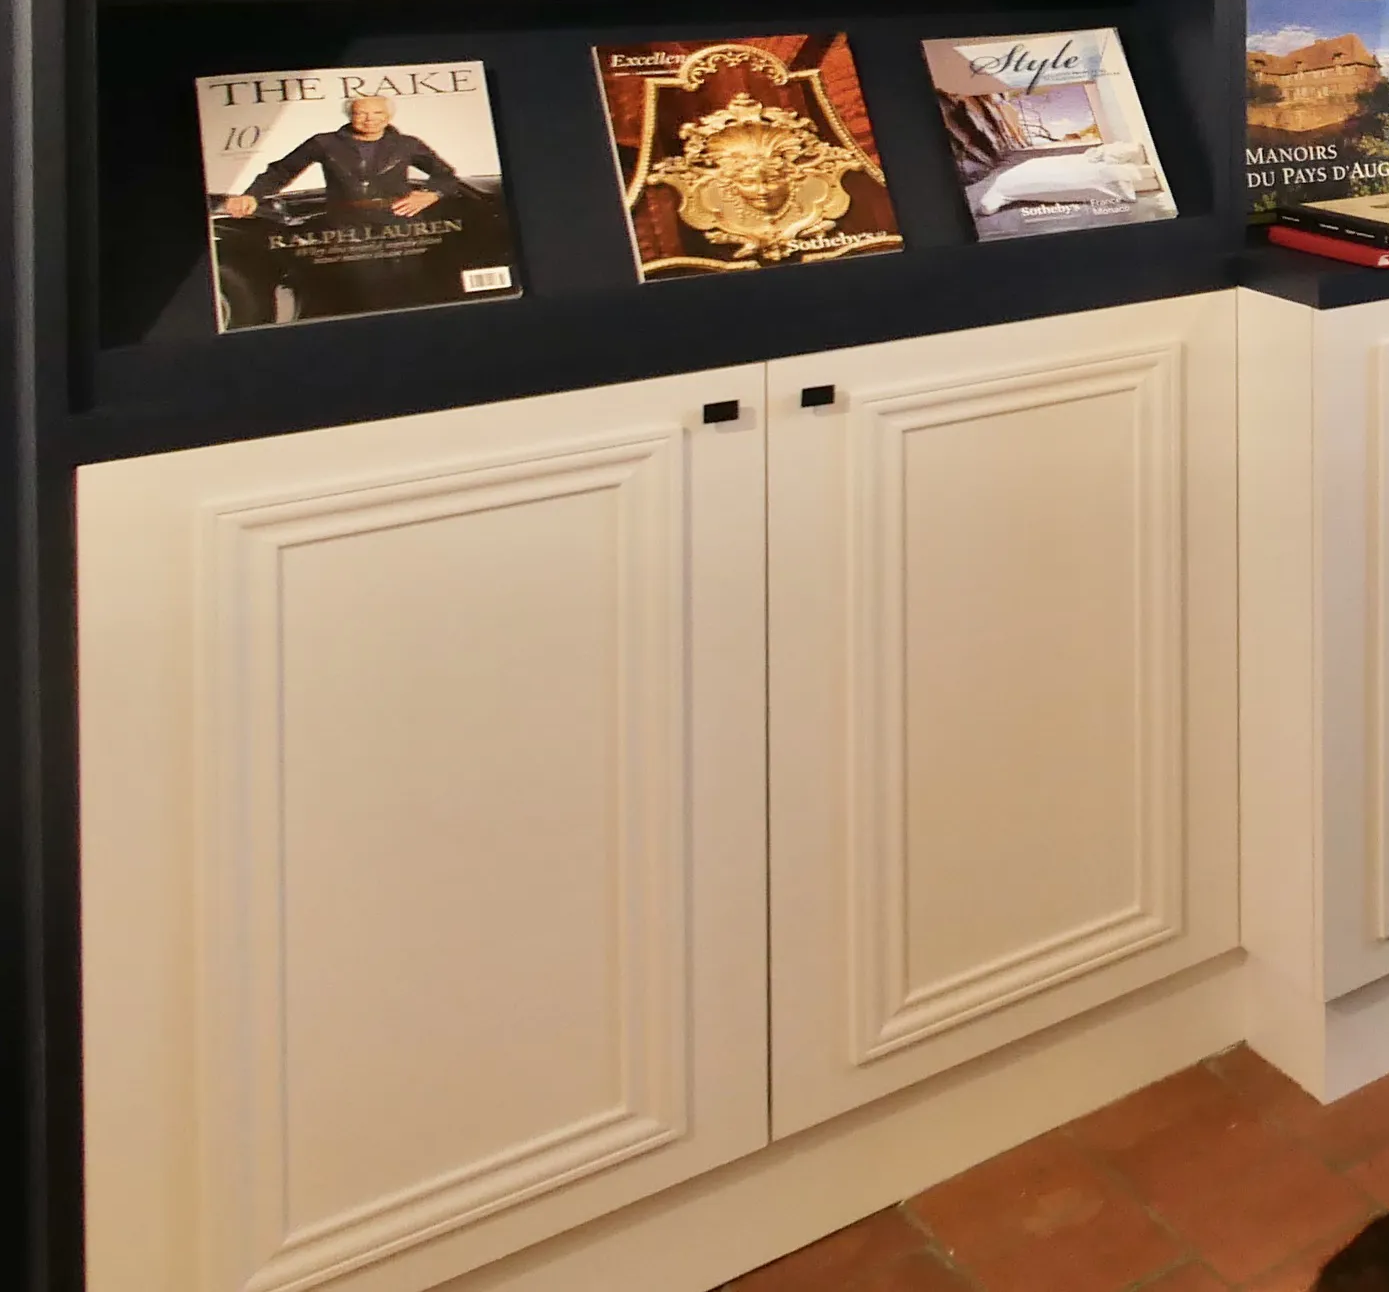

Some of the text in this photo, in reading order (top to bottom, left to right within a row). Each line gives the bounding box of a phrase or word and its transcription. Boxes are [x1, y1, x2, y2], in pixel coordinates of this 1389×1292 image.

[611, 51, 687, 68] Excellen
[969, 39, 1079, 95] Style
[209, 69, 477, 106] THE RAKE
[1245, 144, 1338, 166] MANOIRS
[1247, 171, 1275, 188] DU
[1282, 167, 1327, 185] PAYS
[1021, 203, 1081, 217] Sotheby's
[268, 219, 463, 250] RALPH LAUREN
[786, 231, 874, 252] Sotheby's
